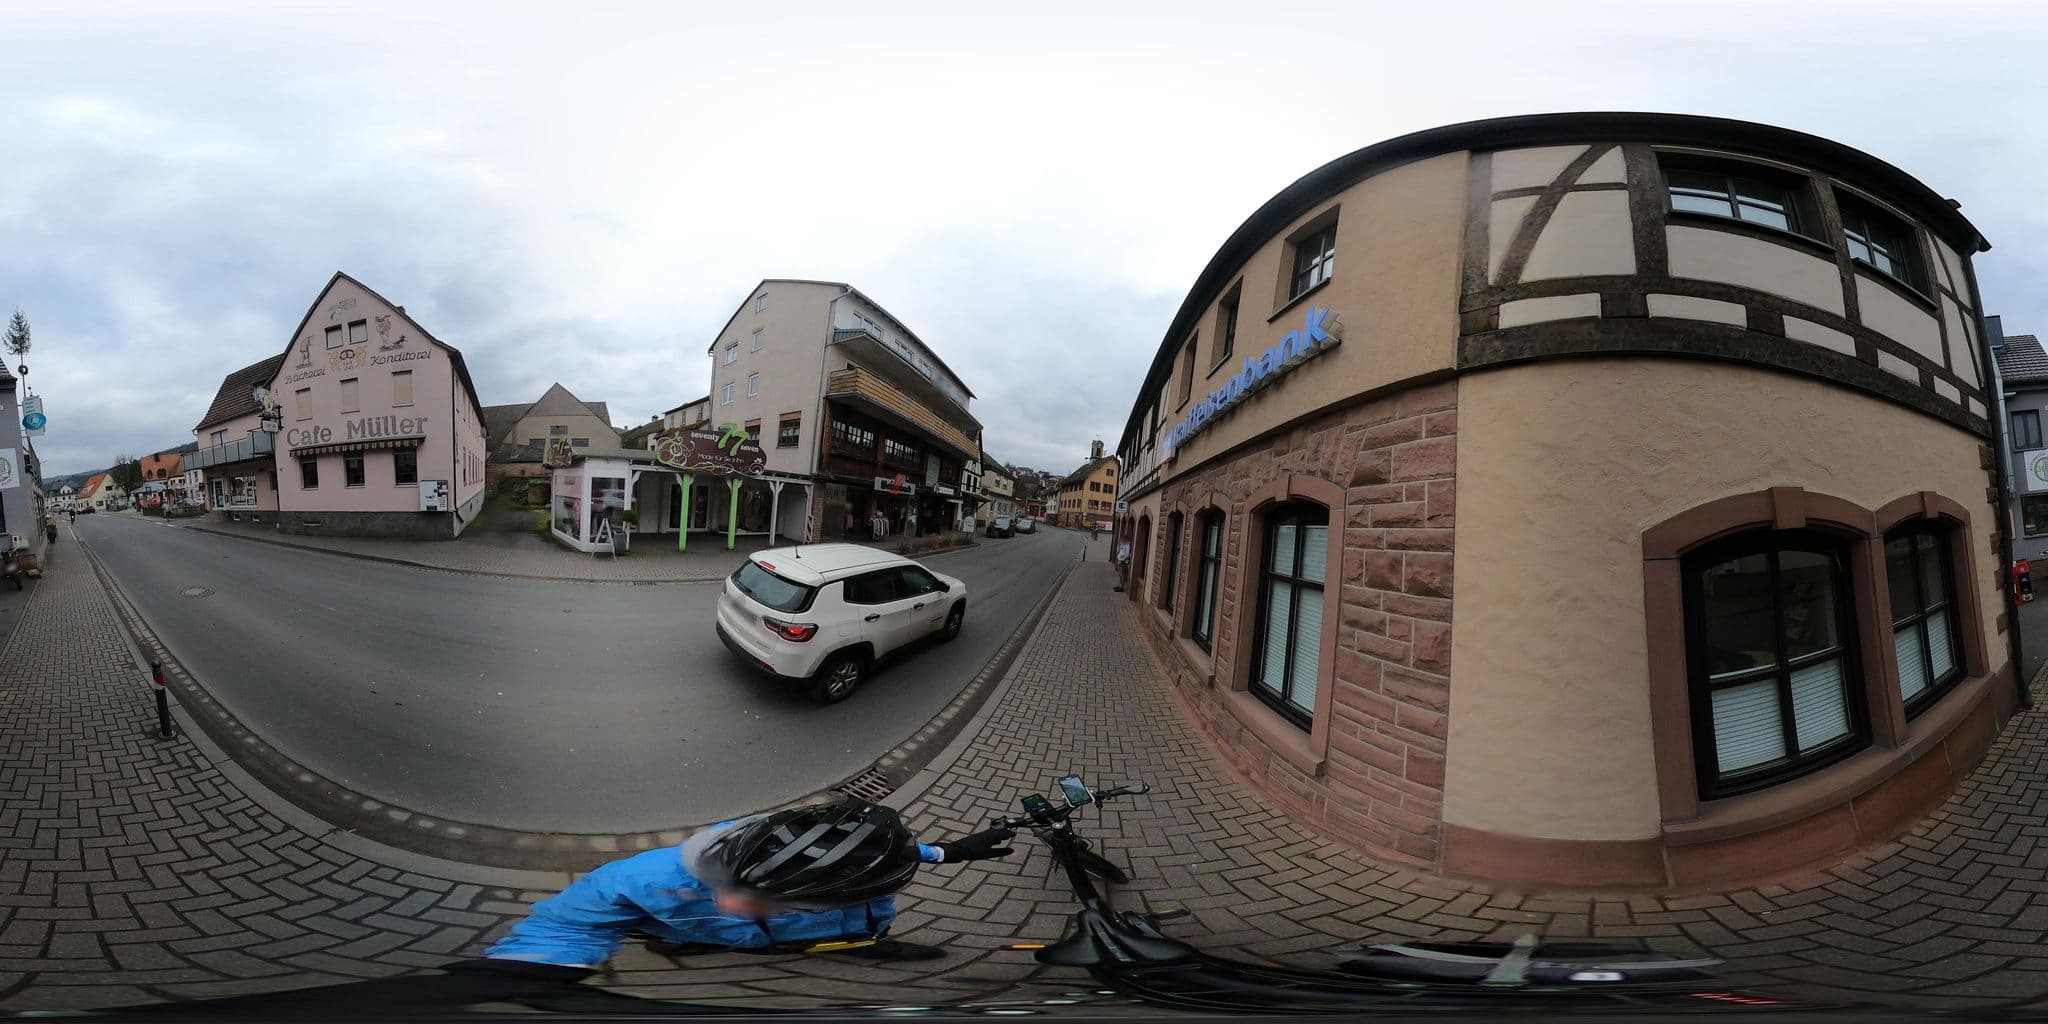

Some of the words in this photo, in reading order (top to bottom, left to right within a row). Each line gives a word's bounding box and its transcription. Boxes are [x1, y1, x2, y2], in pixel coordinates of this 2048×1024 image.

[370, 350, 432, 366] Konditorei
[286, 425, 332, 447] Cafe
[346, 415, 428, 440] Müller
[691, 432, 720, 442] seventy
[718, 423, 749, 456] 77
[740, 445, 759, 453] seven
